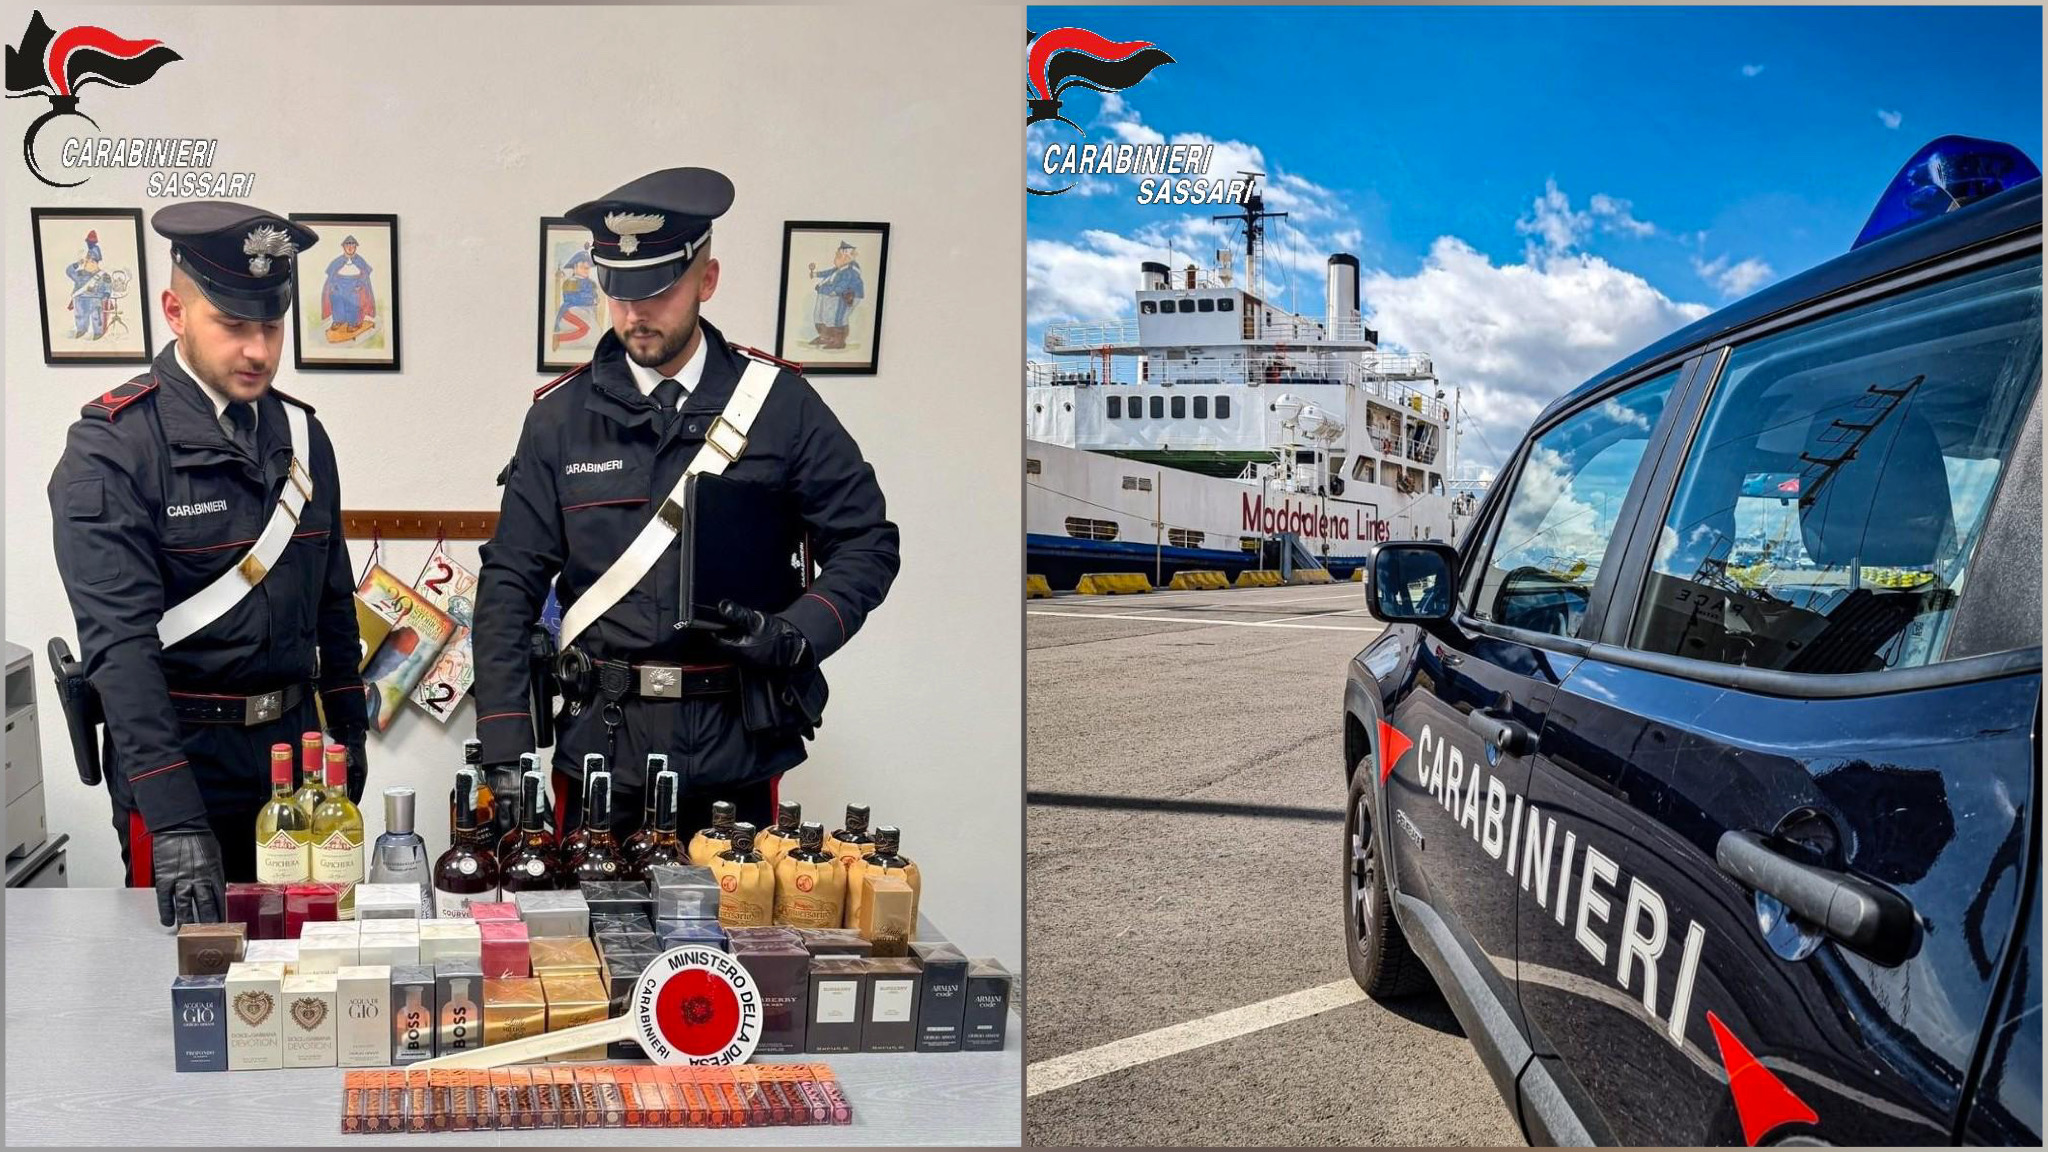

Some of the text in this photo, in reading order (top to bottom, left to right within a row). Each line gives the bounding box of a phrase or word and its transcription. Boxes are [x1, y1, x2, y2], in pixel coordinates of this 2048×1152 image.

[566, 459, 623, 475] CARABINIERI
[166, 499, 228, 517] CARABINIERI
[1242, 491, 1390, 542] Maddalena Lines
[1417, 723, 1706, 1048] CARABINIERI
[668, 951, 746, 989] MINISTERO
[737, 990, 756, 1043] DELLA
[933, 984, 959, 992] ARMANI
[408, 1011, 420, 1050] BOSS
[453, 1006, 467, 1049] BOSS
[639, 978, 671, 1060] CARABINIERI
